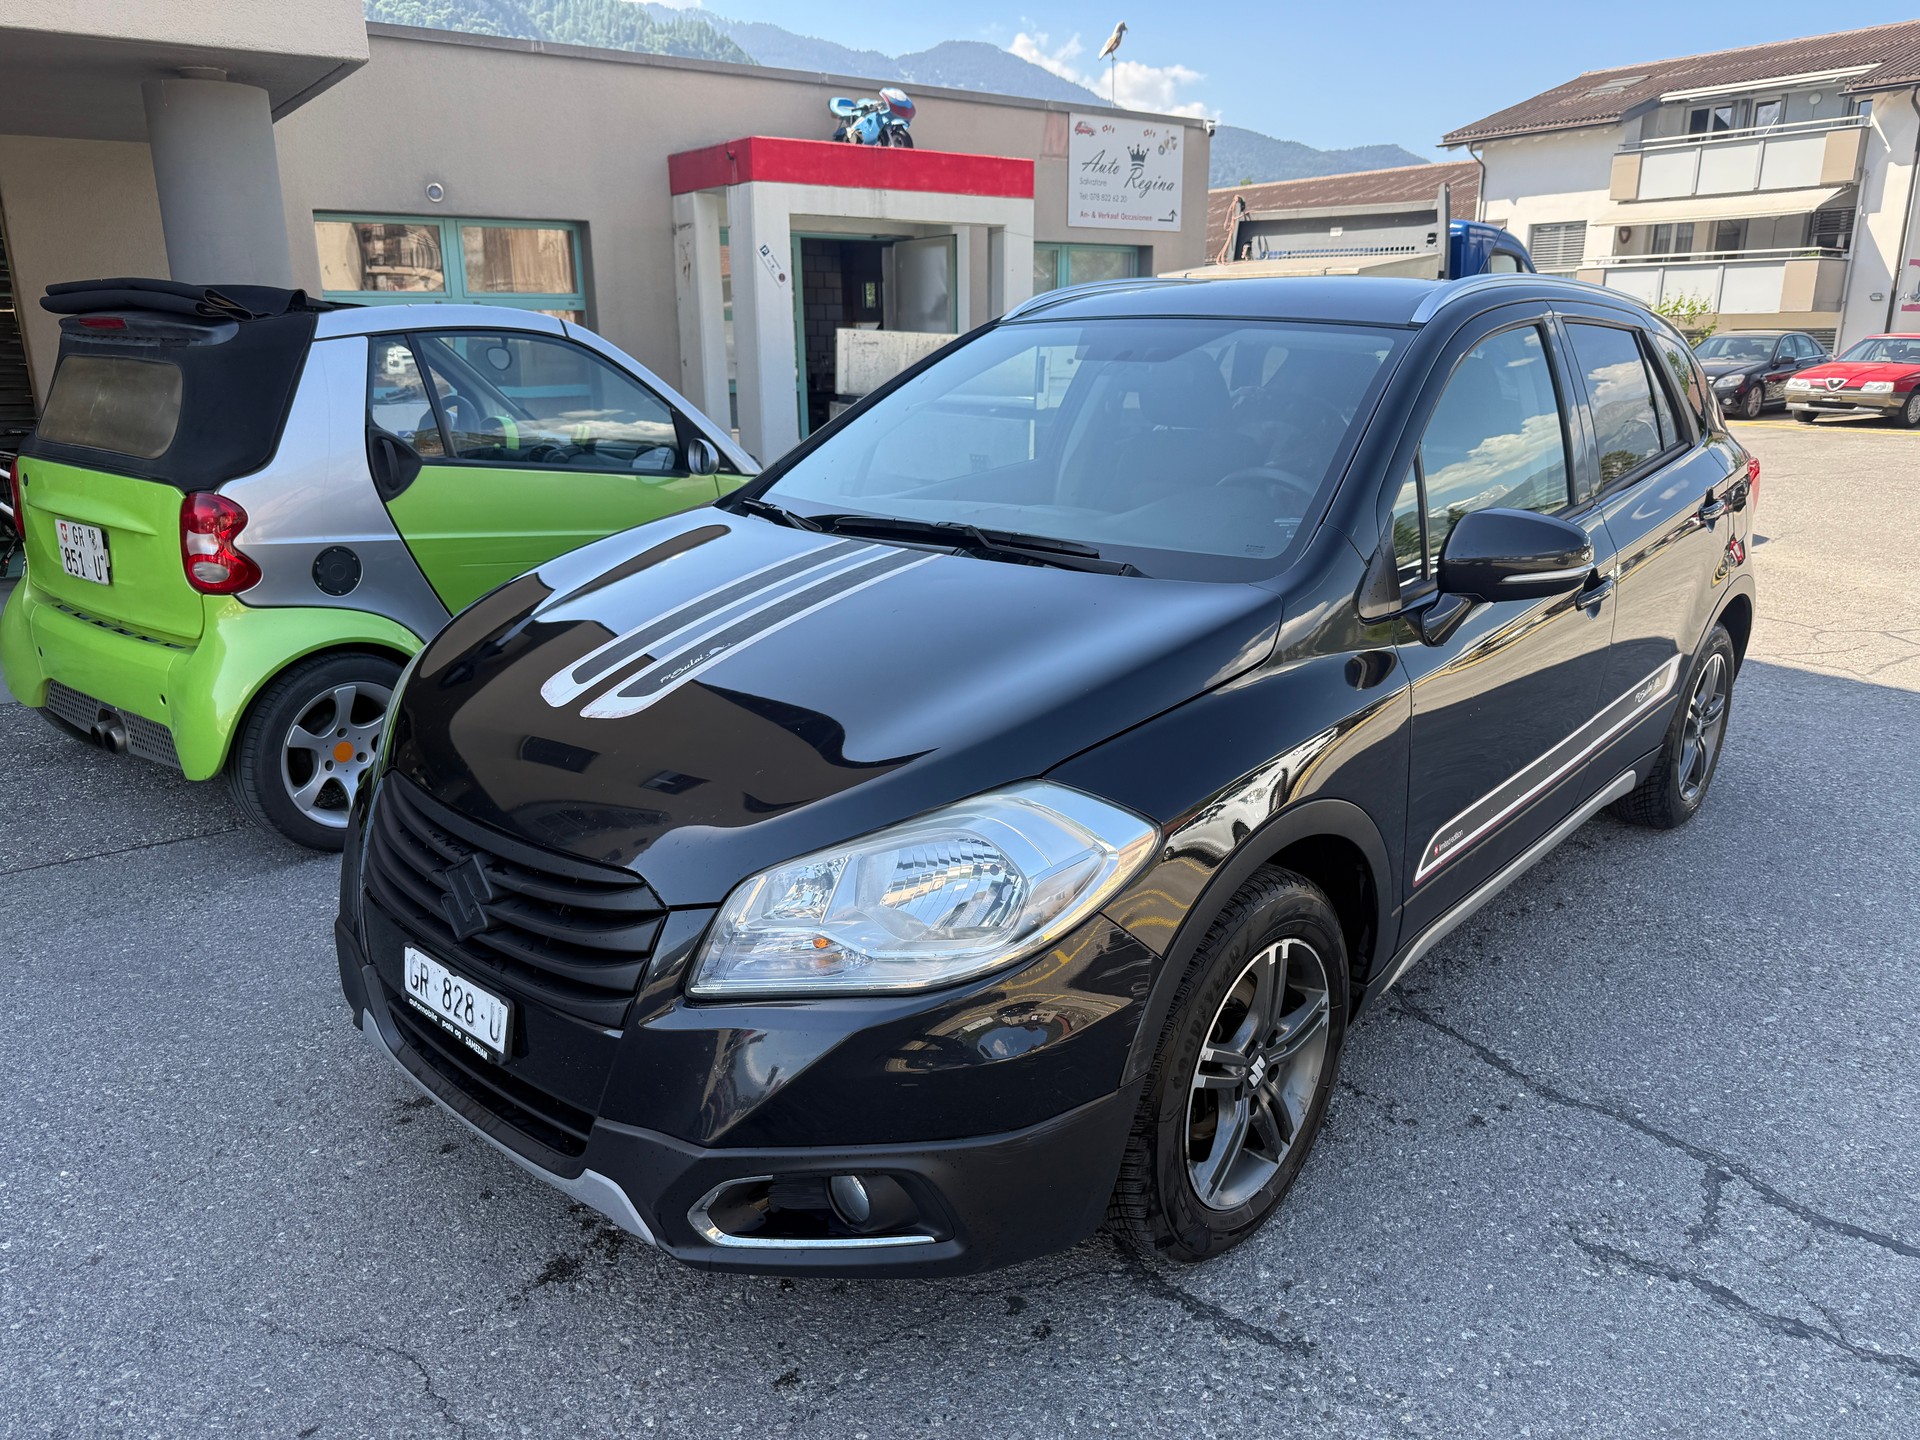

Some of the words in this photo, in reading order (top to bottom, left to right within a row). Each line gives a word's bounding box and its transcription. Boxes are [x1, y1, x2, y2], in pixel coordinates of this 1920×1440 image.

[1079, 178, 1108, 187] Salvatore
[1081, 149, 1121, 175] Auto
[1124, 166, 1176, 199] Regina
[1089, 193, 1100, 201] 078
[1079, 210, 1090, 218] An-
[1097, 211, 1119, 220] Verkauf
[1120, 212, 1153, 222] Occasionen
[72, 526, 85, 548] GR
[64, 547, 86, 577] 851
[93, 555, 102, 580] U
[409, 953, 430, 1001] GR
[442, 977, 476, 1028] 828
[489, 1002, 503, 1044] U
[465, 1036, 488, 1061] SAMEDAN
